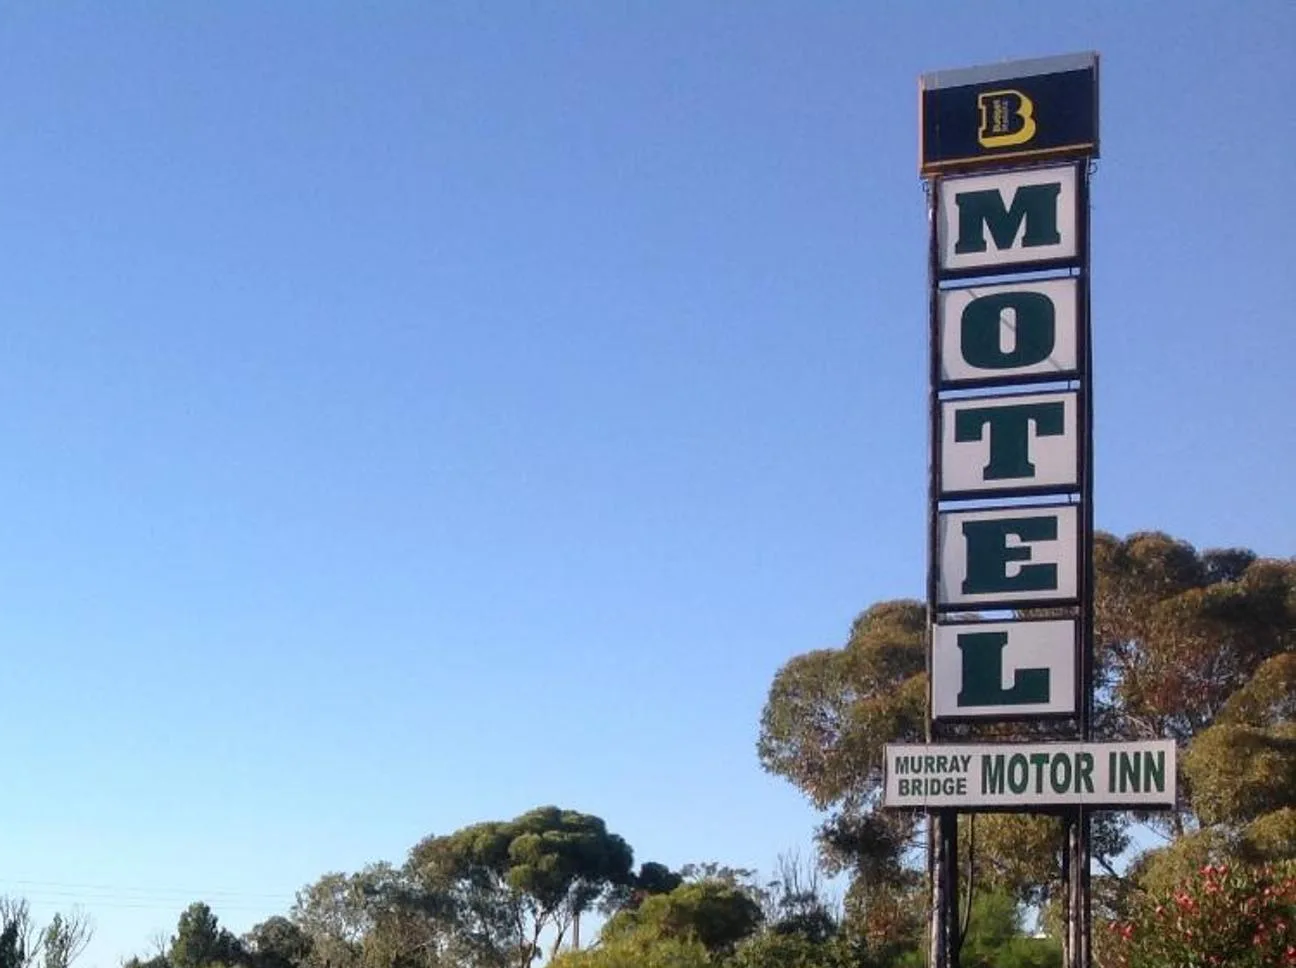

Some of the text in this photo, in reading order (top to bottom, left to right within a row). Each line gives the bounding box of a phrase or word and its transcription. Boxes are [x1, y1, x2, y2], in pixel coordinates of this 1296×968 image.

[978, 89, 1036, 148] B
[954, 182, 1065, 707] MOTEL
[895, 754, 971, 775] MURRAY
[898, 777, 967, 797] BRIDGE
[980, 750, 1165, 795] MOTOR INN
